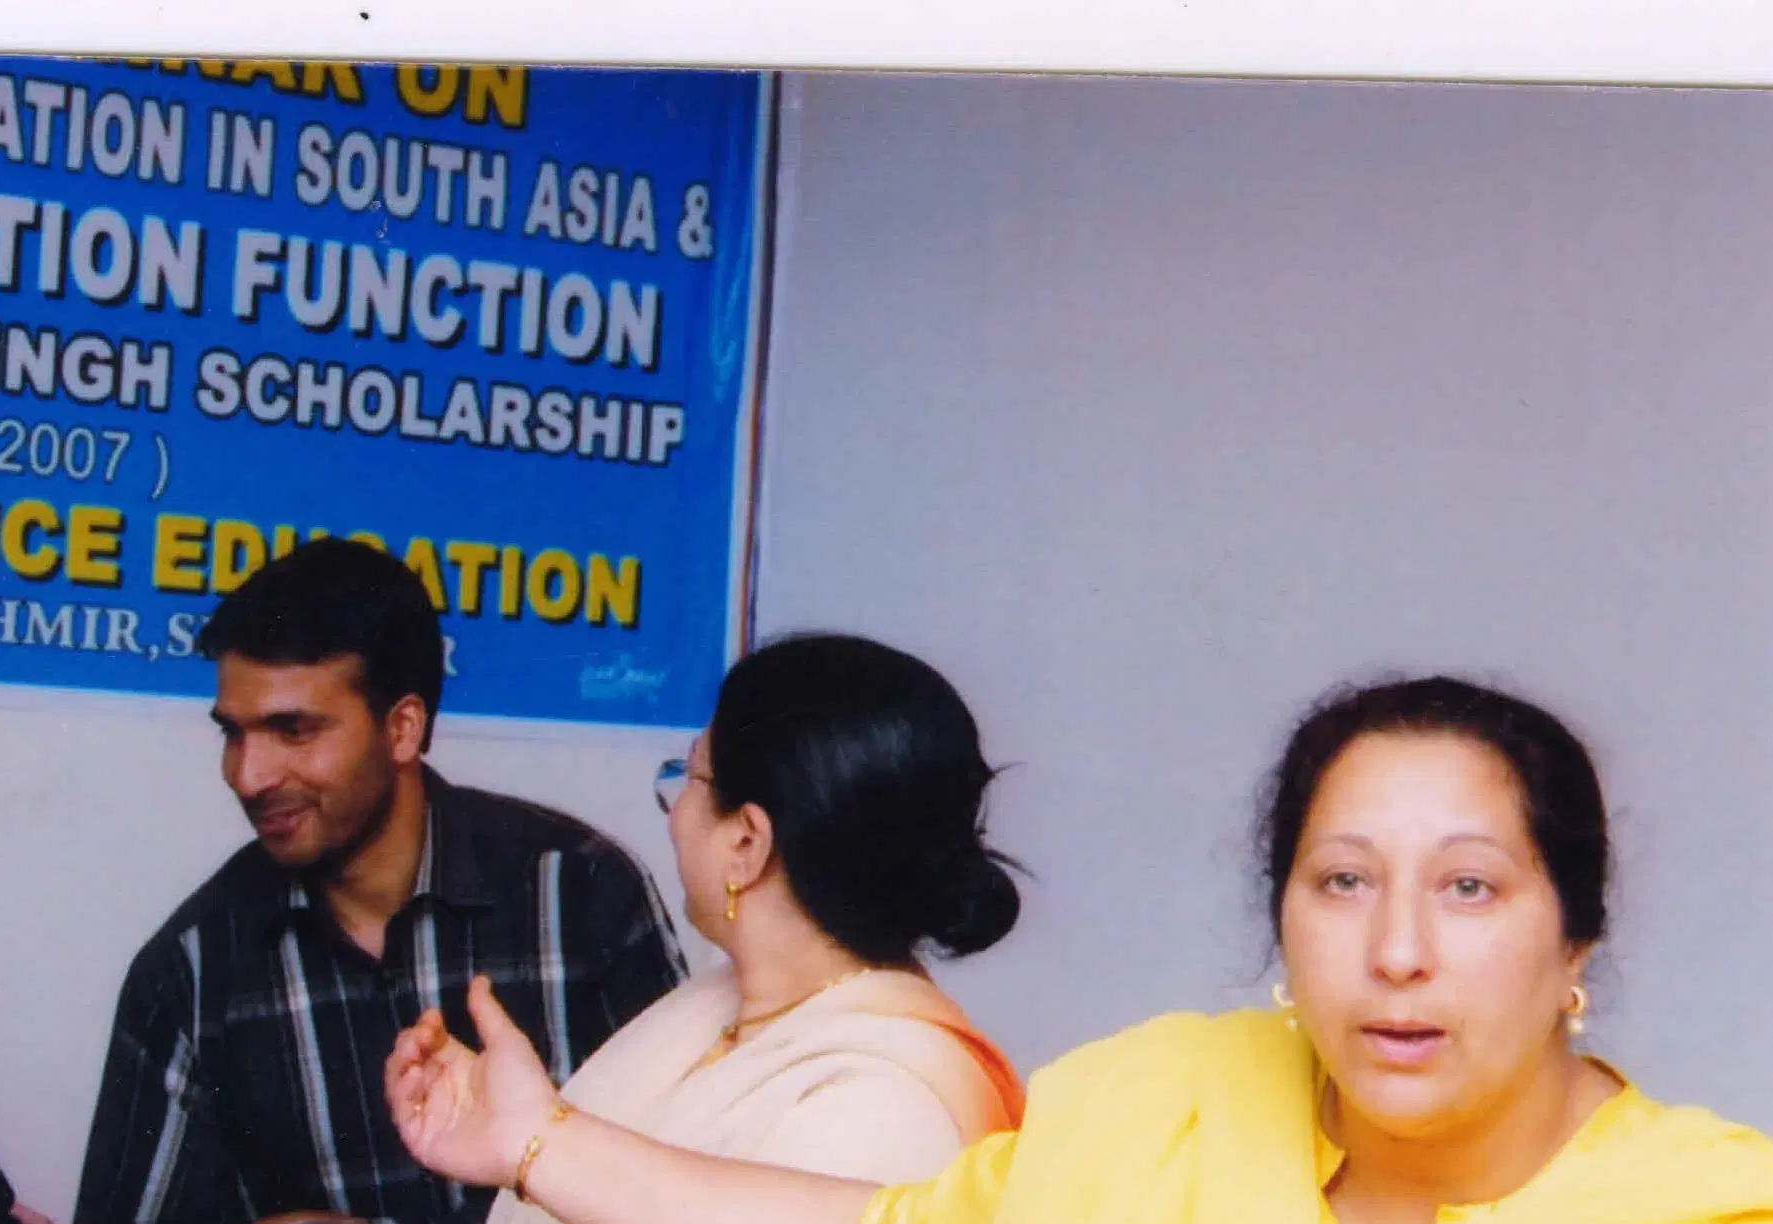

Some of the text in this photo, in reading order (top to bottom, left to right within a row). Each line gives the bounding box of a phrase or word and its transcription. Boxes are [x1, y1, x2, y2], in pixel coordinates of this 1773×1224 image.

[209, 113, 272, 194] IN
[296, 127, 504, 228] SOUTH
[526, 164, 655, 248] ASIA
[678, 187, 711, 256] &
[234, 231, 658, 365] FUNCTION
[197, 352, 684, 462] SCHOLARSHIP
[152, 514, 640, 623] EDATION
